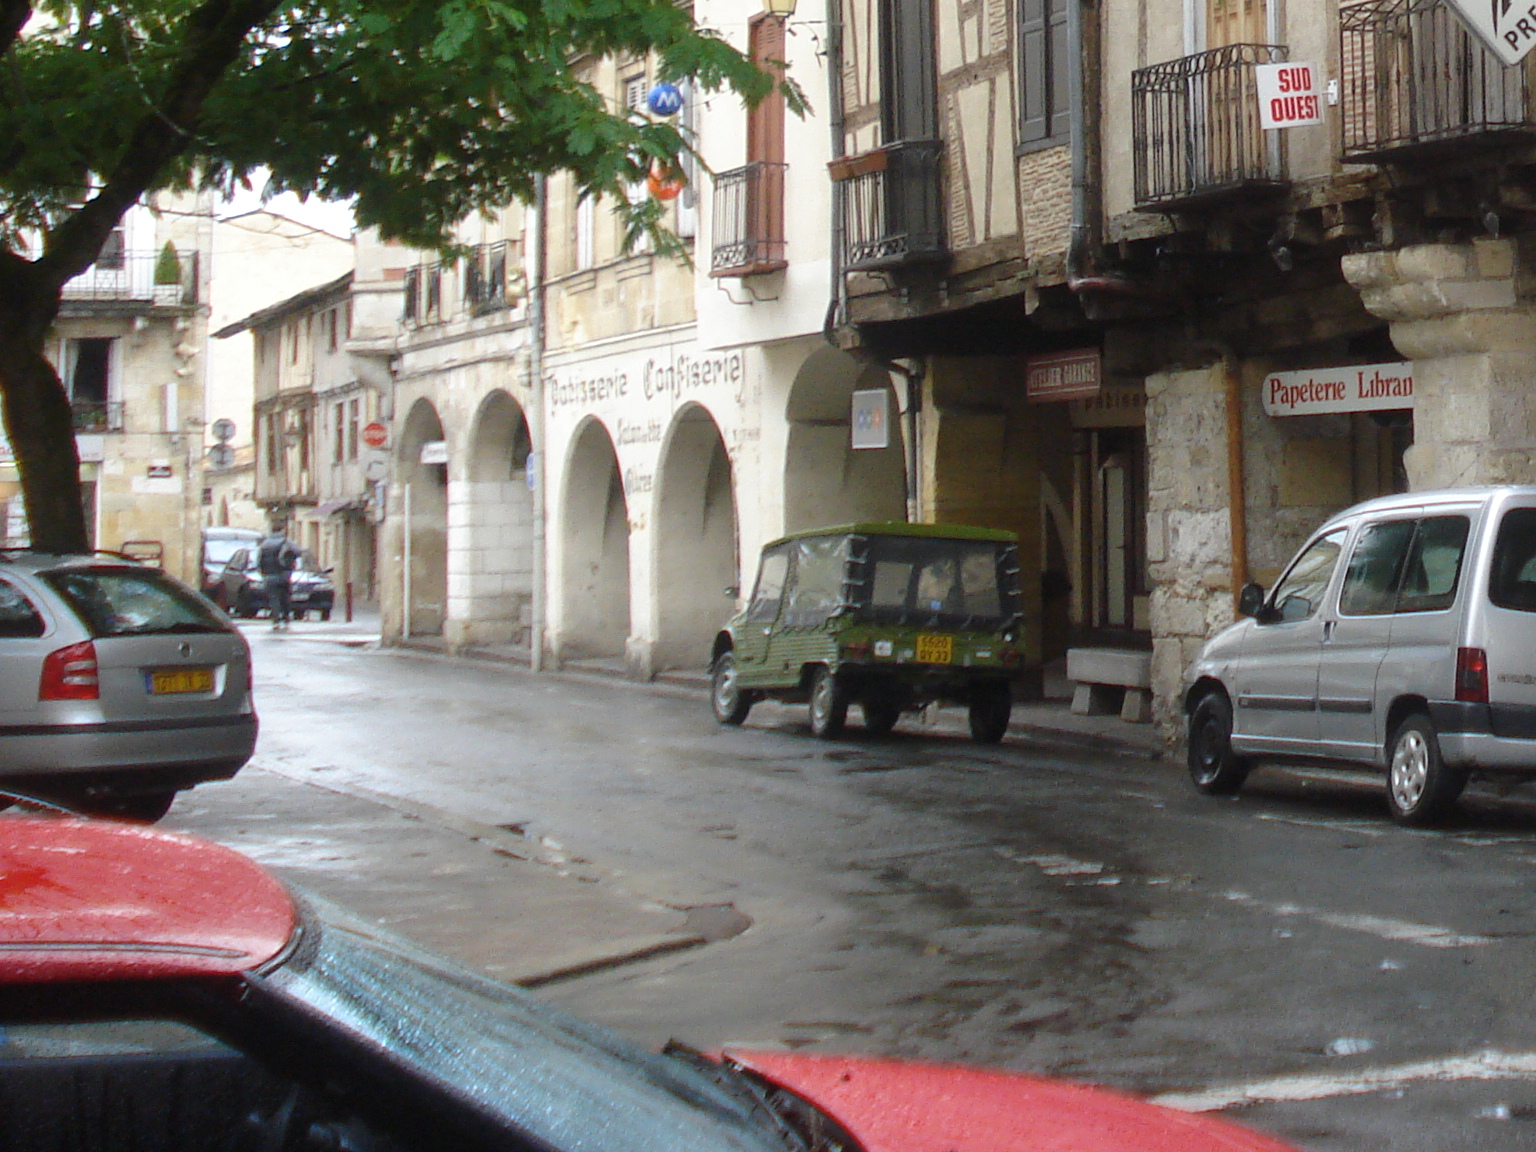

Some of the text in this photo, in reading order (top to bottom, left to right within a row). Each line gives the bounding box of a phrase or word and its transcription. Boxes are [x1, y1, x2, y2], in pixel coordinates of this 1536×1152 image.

[1278, 67, 1312, 93] SUD
[1270, 95, 1320, 122] OUEST
[643, 350, 742, 401] Confiserie
[1269, 378, 1347, 409] Papeterie
